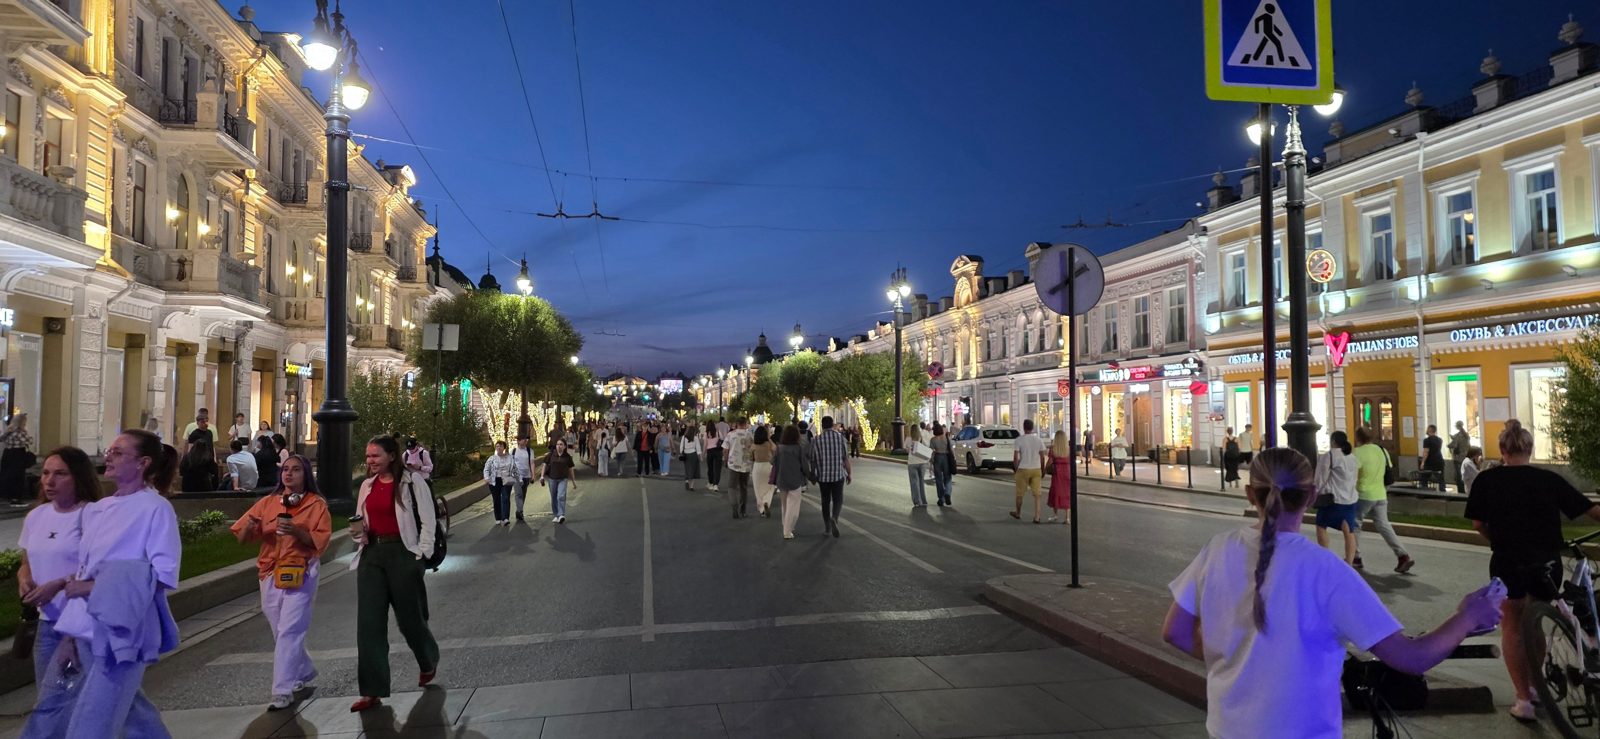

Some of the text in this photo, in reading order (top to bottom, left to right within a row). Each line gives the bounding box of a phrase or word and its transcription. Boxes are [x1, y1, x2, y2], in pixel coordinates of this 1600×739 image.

[1450, 326, 1492, 342] ОБУВЬ
[1494, 324, 1505, 338] &
[1347, 339, 1384, 353] ITALIAN
[1385, 335, 1419, 350] SHOES
[1229, 353, 1252, 365] ОБУВЬ
[1252, 352, 1259, 362] &
